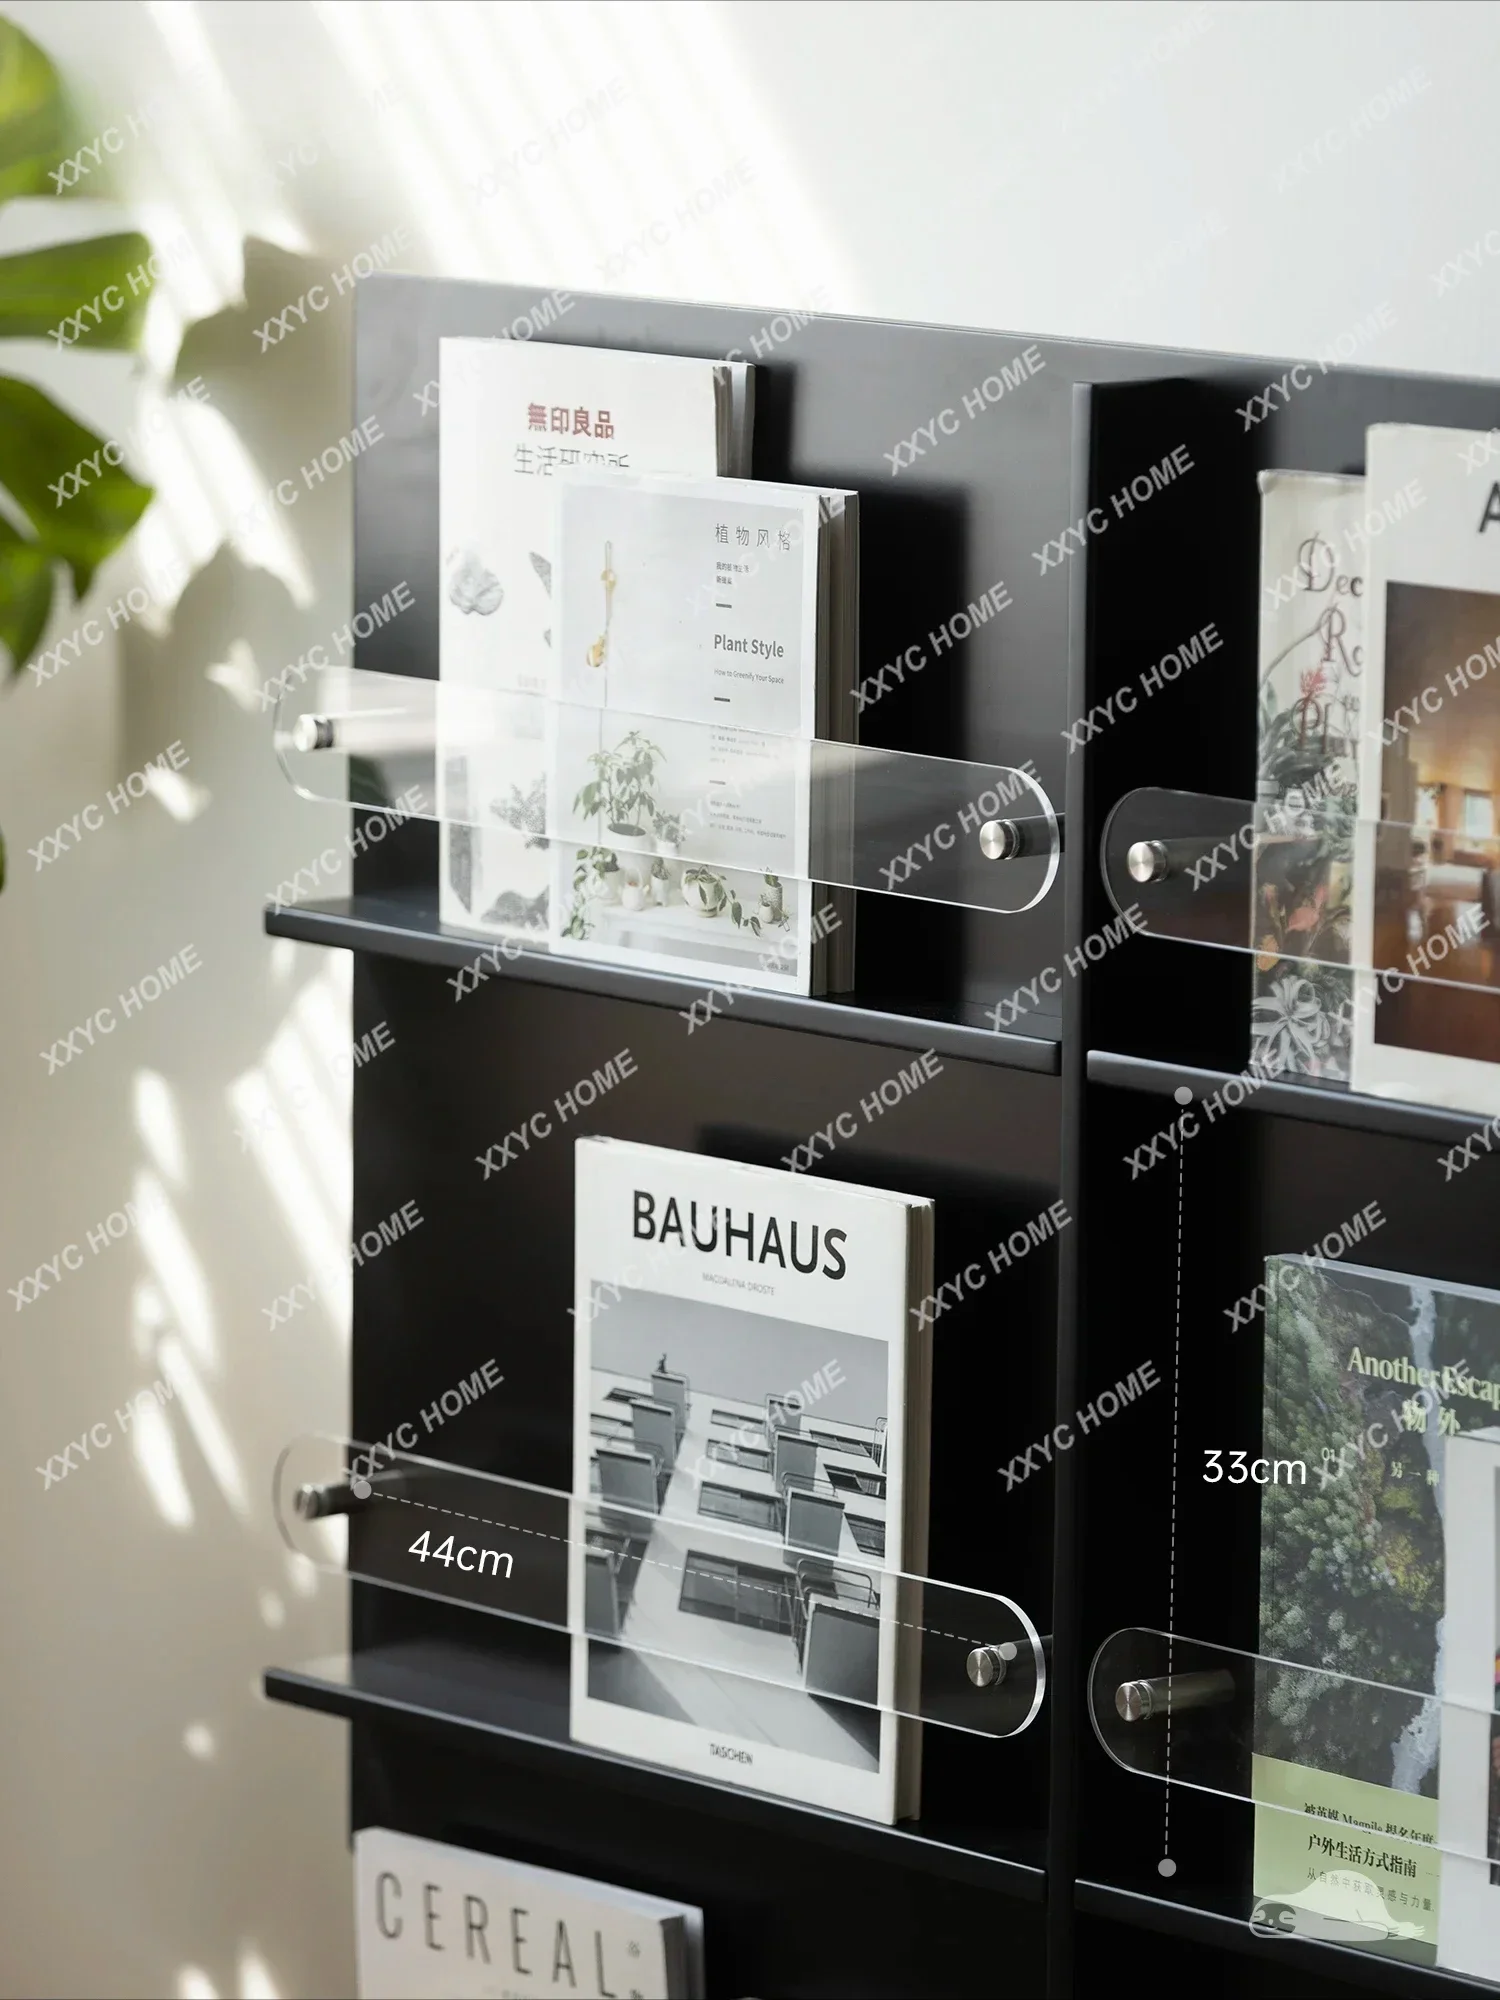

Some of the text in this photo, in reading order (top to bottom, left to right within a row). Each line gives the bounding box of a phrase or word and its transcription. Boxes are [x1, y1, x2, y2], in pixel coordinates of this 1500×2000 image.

[528, 402, 615, 439] 無印良品
[715, 523, 791, 551] 植物风格
[714, 634, 784, 660] Plant Style
[714, 668, 726, 676] How
[726, 670, 732, 678] to
[755, 673, 768, 682] Your
[768, 675, 784, 684] Space
[633, 1189, 848, 1281] BAUHAUS
[748, 1281, 775, 1296] DROSTE
[1347, 1346, 1440, 1387] Another
[1308, 1834, 1417, 1878] 户外生活方式指南
[375, 1871, 617, 1998] CEREAL
